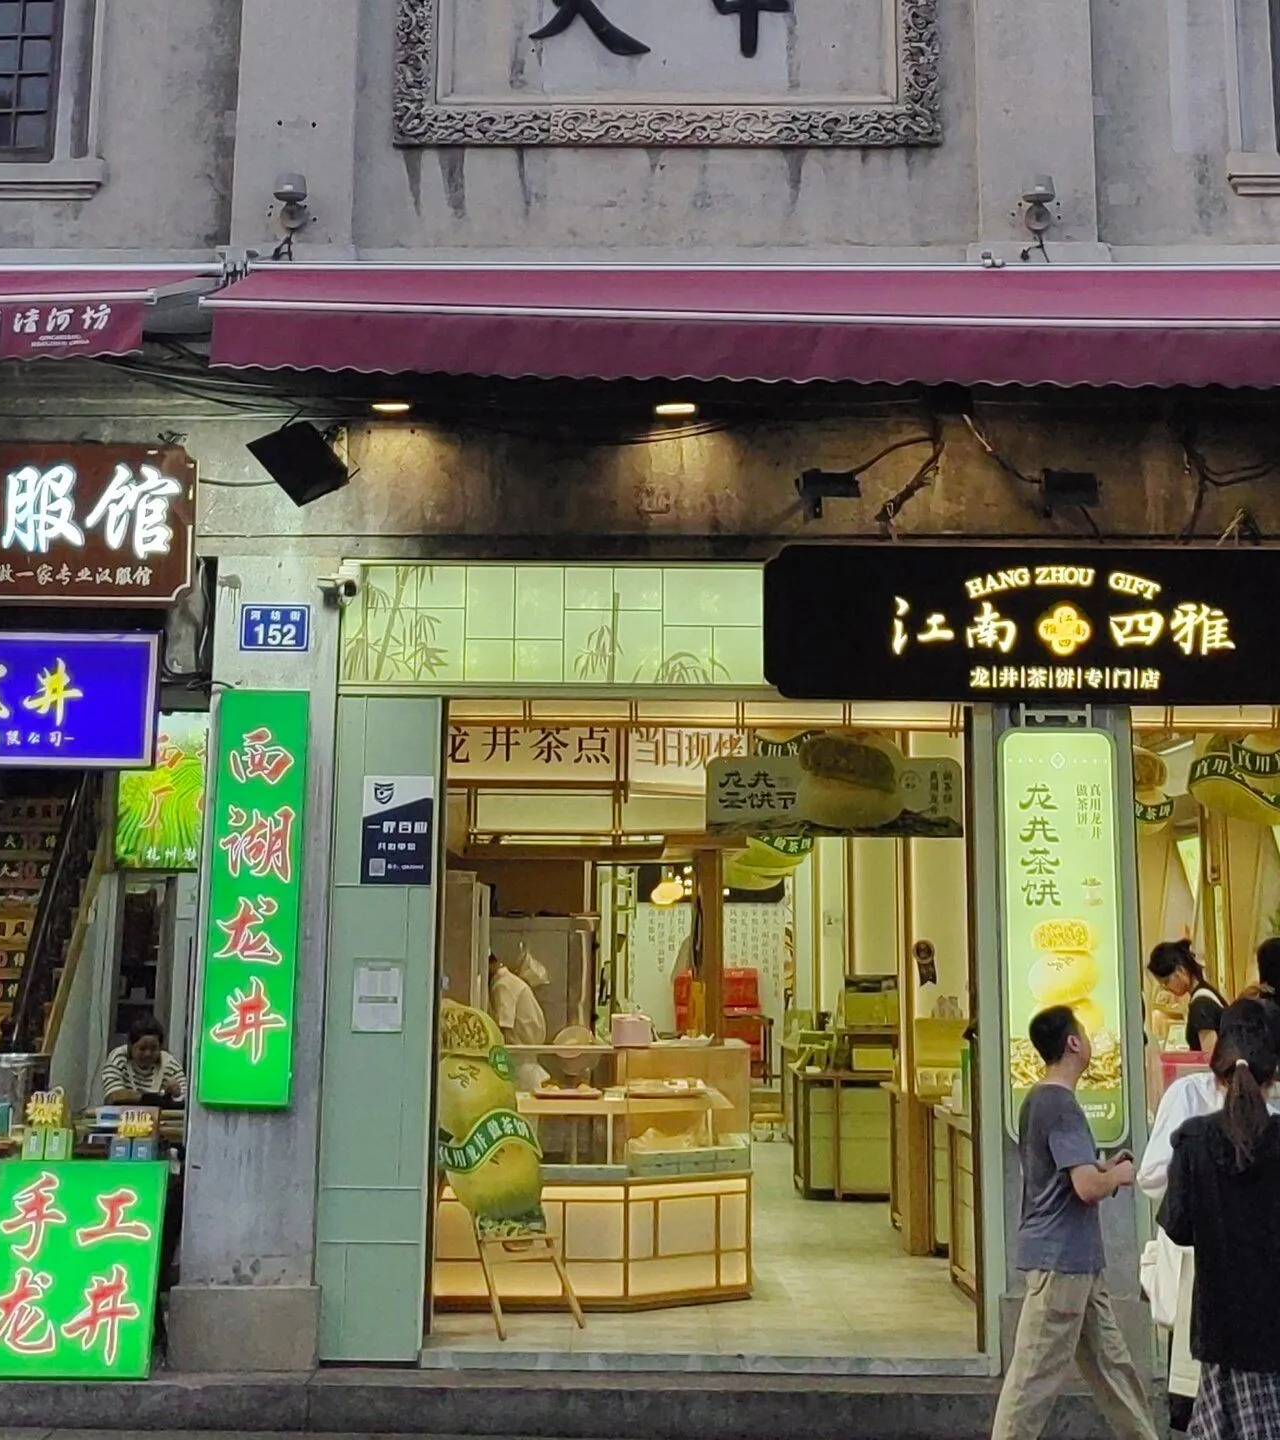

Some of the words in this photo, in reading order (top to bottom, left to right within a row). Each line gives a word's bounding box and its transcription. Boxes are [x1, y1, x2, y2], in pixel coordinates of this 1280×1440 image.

[13, 304, 111, 333] 清河坊
[965, 567, 1030, 599] HANG
[1035, 566, 1095, 586] ZHOU
[1108, 572, 1162, 600] GIFT
[250, 610, 301, 621] 河坊街
[253, 624, 297, 646] 152
[892, 596, 1018, 656] 江南
[1109, 602, 1236, 656] 四雅
[1019, 782, 1062, 907] 龙井茶饼
[210, 726, 296, 1065] 西湖龙井
[0, 1171, 152, 1262] 手工
